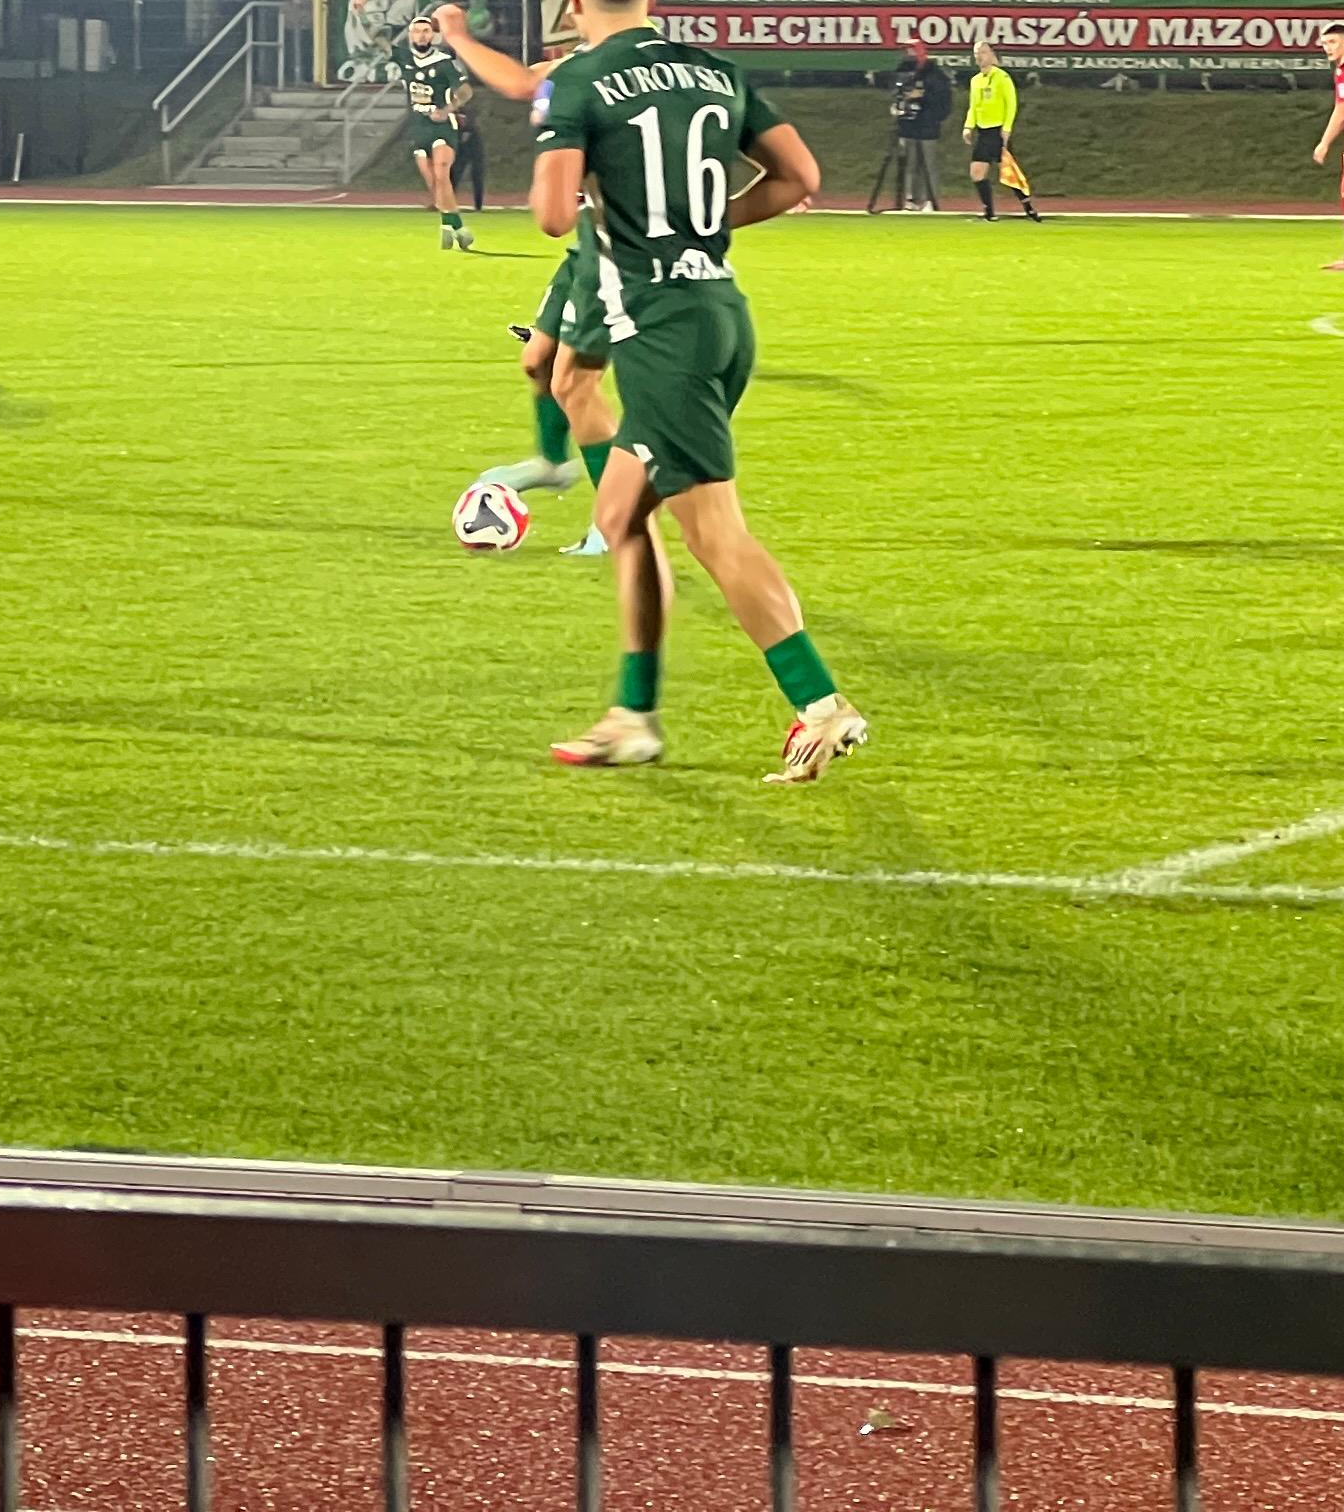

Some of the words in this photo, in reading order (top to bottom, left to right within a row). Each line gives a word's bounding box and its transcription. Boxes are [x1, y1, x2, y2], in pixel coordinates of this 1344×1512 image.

[726, 16, 883, 45] LECHIA
[891, 11, 1139, 47] TOMASZÓW
[592, 62, 737, 106] KUROWSKI
[627, 103, 730, 238] 16
